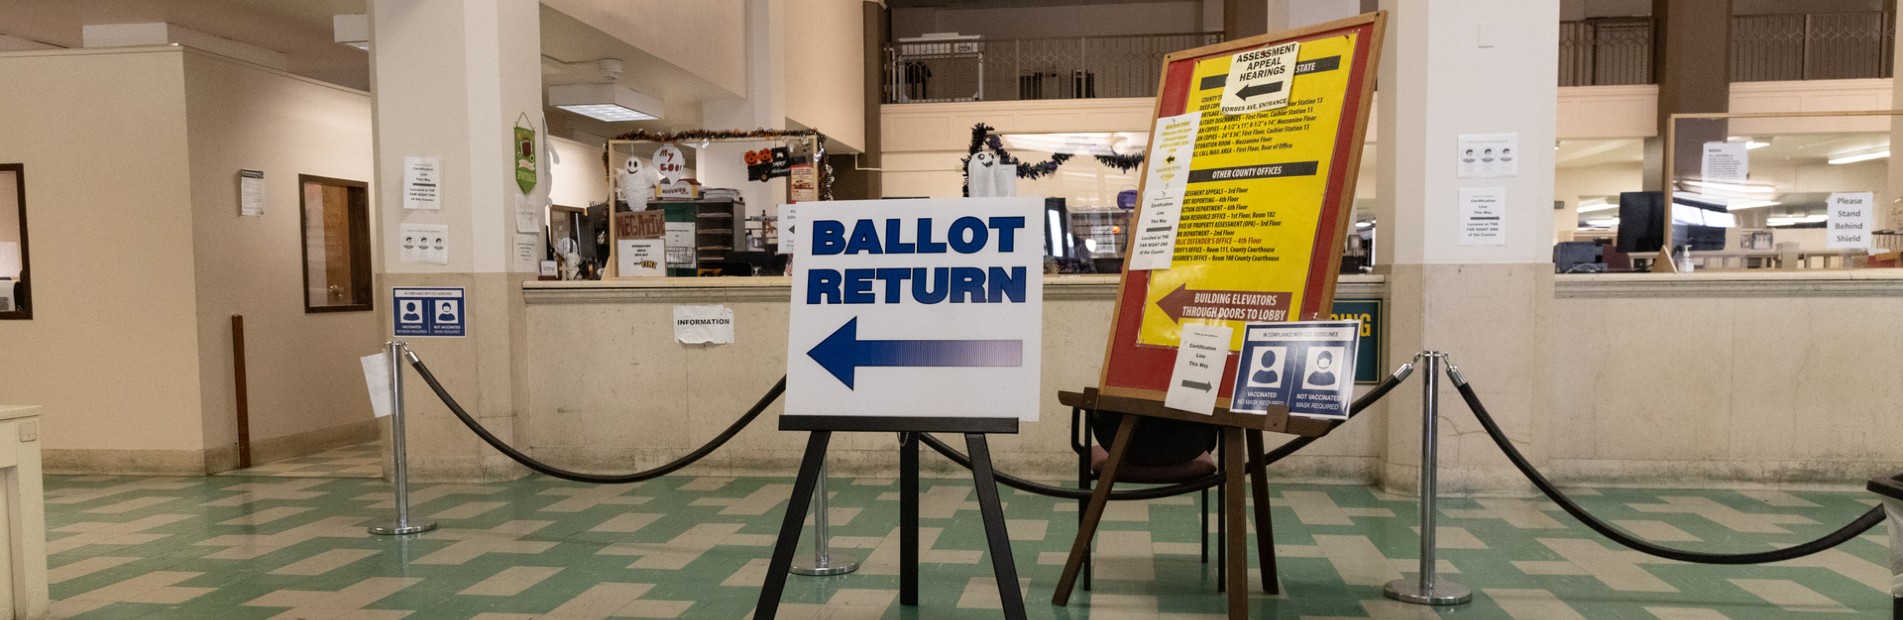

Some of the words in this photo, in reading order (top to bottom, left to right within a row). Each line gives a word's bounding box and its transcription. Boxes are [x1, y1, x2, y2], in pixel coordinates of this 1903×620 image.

[1236, 43, 1297, 63] ASSESSMENT
[1246, 57, 1282, 71] APPEAL
[1296, 62, 1316, 73] STATE
[1239, 65, 1286, 82] HEARINGS
[1201, 95, 1217, 103] COUNTY
[1259, 98, 1287, 108] ENTRANCE
[660, 149, 674, 163] My
[1212, 169, 1231, 179] OTHER
[1232, 167, 1257, 178] COUNTY
[1257, 166, 1282, 176] OFFICES
[1837, 197, 1863, 205] Please
[1243, 220, 1256, 228] (OPA)
[811, 215, 1026, 256] BALLOT
[1187, 237, 1215, 245] DEFENDER'S
[1230, 246, 1247, 254] County
[806, 266, 1027, 305] RETURN
[1194, 293, 1231, 304] BUILDING
[1232, 294, 1277, 306] ELEVATORS
[1182, 306, 1217, 317] THROUGH
[1218, 307, 1245, 319] DOORS
[1247, 309, 1258, 319] TO
[1258, 309, 1287, 321] LOBBY
[1189, 343, 1216, 351] Certification
